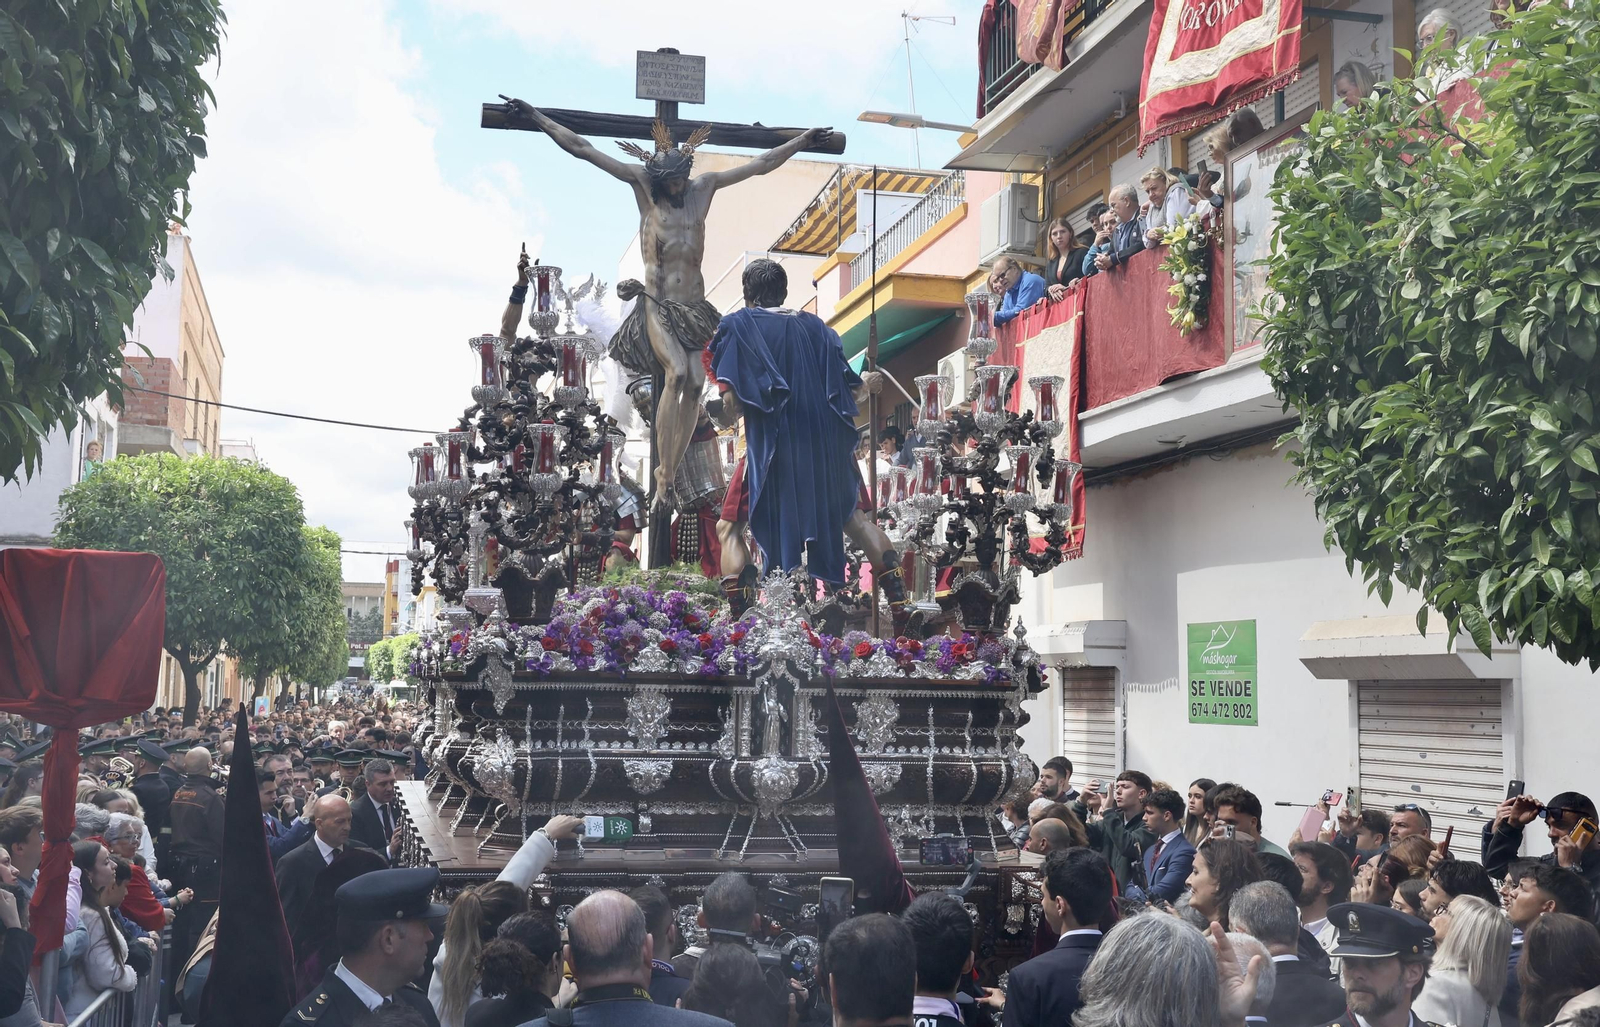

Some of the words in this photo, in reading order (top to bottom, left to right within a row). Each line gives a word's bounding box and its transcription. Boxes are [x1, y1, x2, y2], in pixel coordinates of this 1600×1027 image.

[1202, 651, 1238, 668] máshogar
[1191, 680, 1205, 697] SE
[1210, 680, 1252, 697] VENDE
[1191, 702, 1209, 717] 674
[1212, 702, 1230, 718] 472
[1233, 703, 1252, 719] 802
